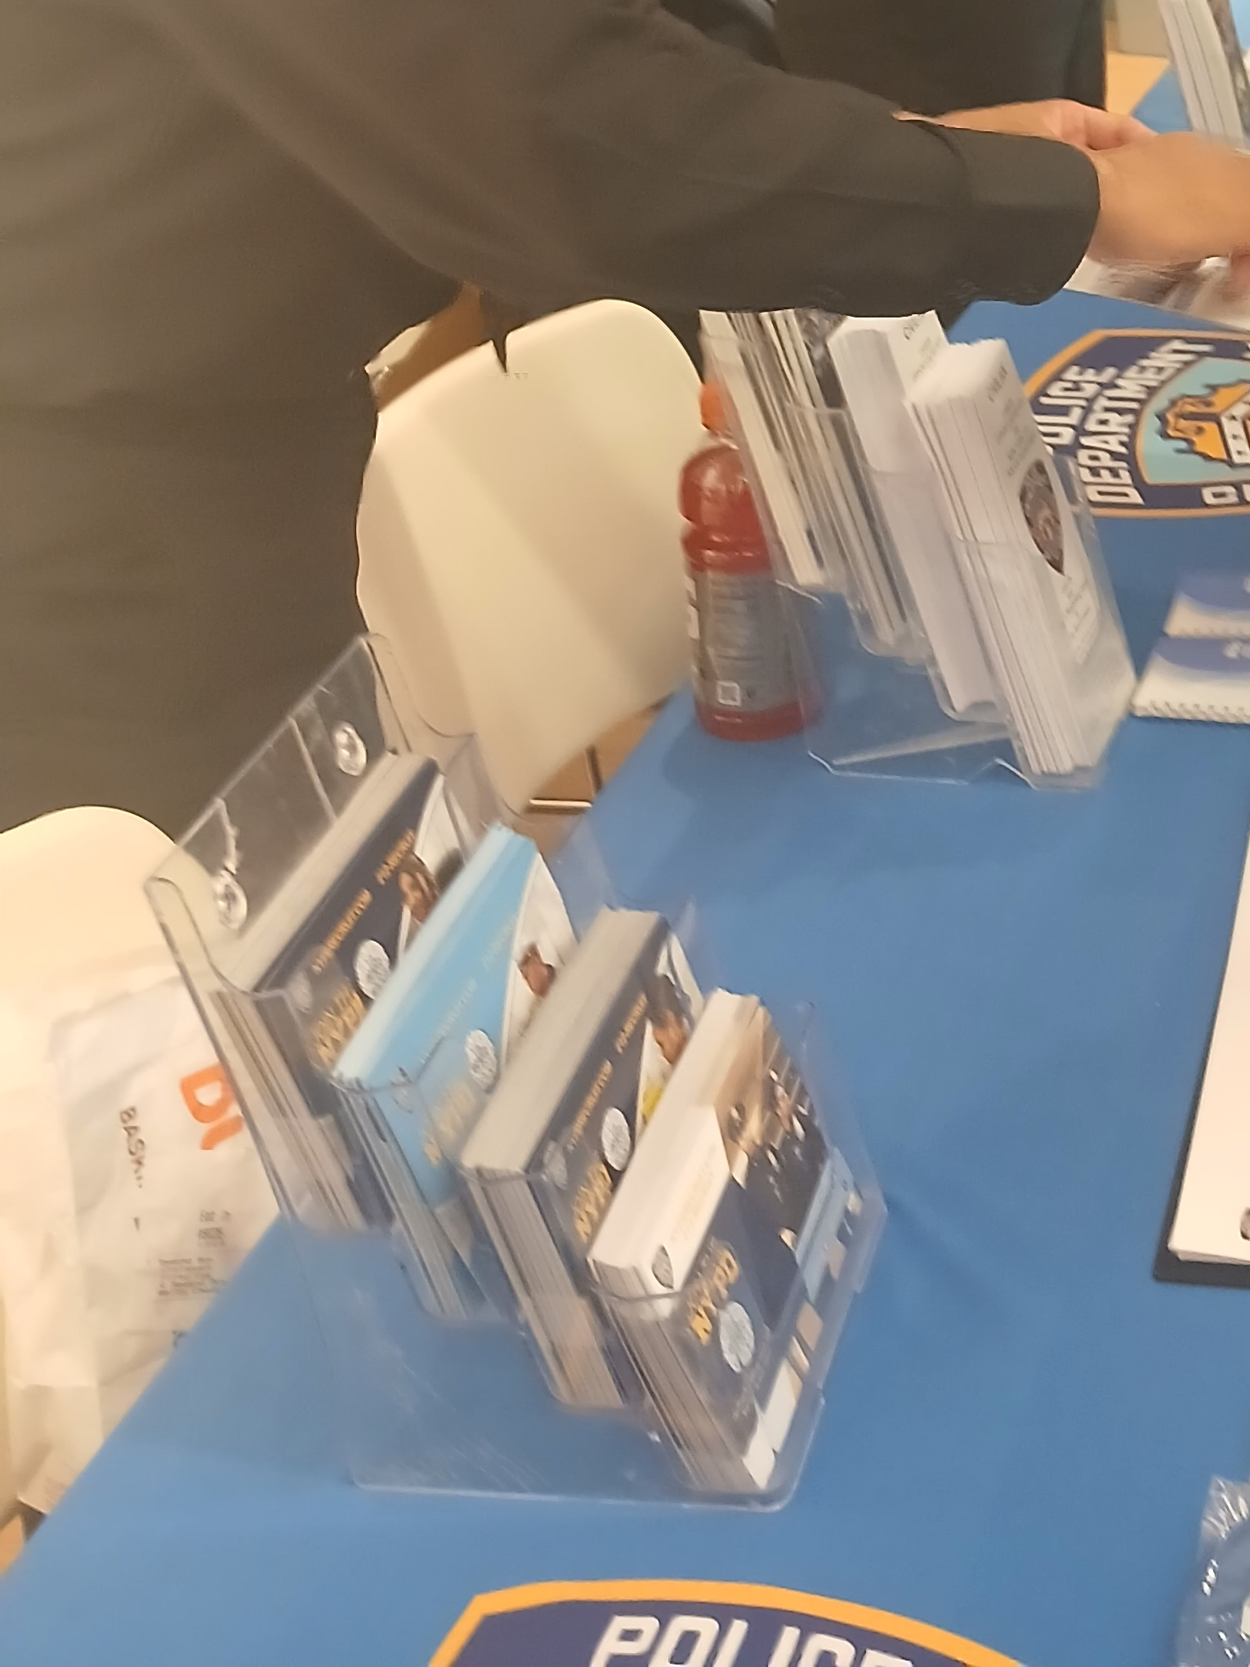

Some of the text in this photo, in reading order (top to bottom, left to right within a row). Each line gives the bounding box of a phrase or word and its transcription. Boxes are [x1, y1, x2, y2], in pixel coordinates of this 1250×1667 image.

[1033, 365, 1119, 456] OLICE
[1077, 339, 1215, 506] DEPARTMENT
[688, 1246, 741, 1347] NYPD
